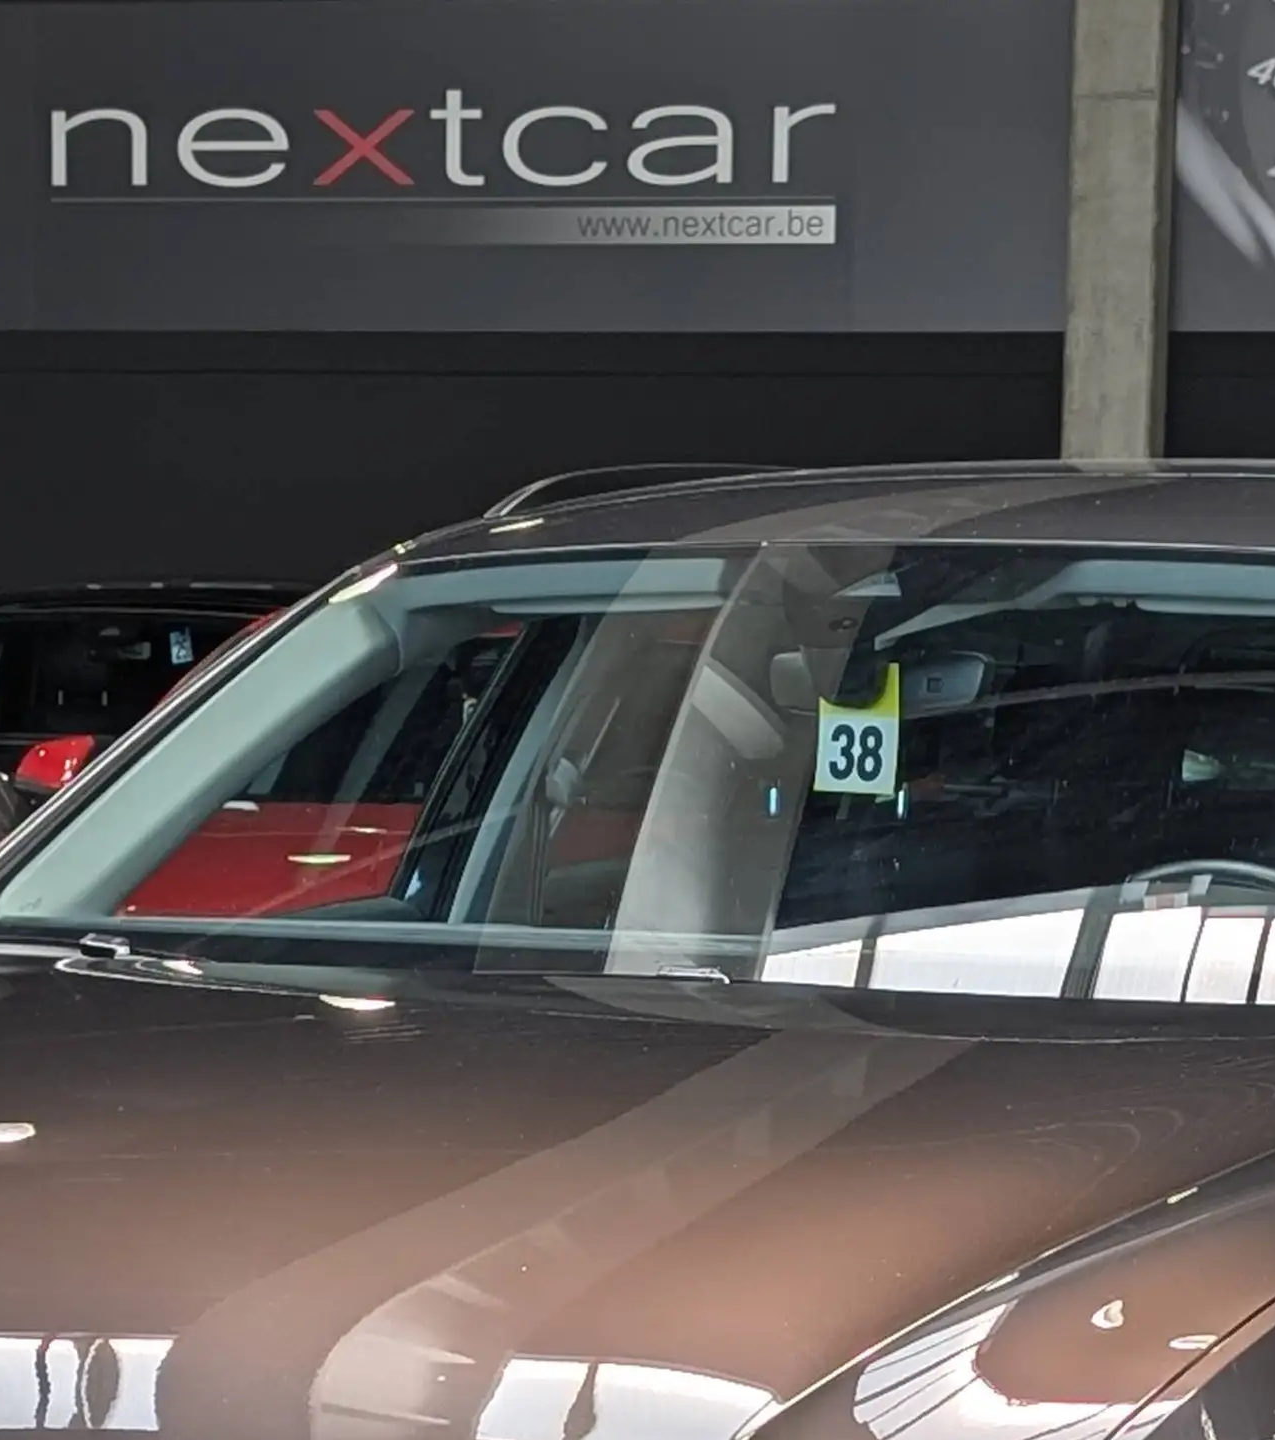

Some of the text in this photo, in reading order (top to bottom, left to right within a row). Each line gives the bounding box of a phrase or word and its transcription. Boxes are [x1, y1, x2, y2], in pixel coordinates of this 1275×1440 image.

[50, 88, 837, 188] nextcar
[576, 209, 825, 240] www.nextcar.be
[828, 723, 884, 782] 38
